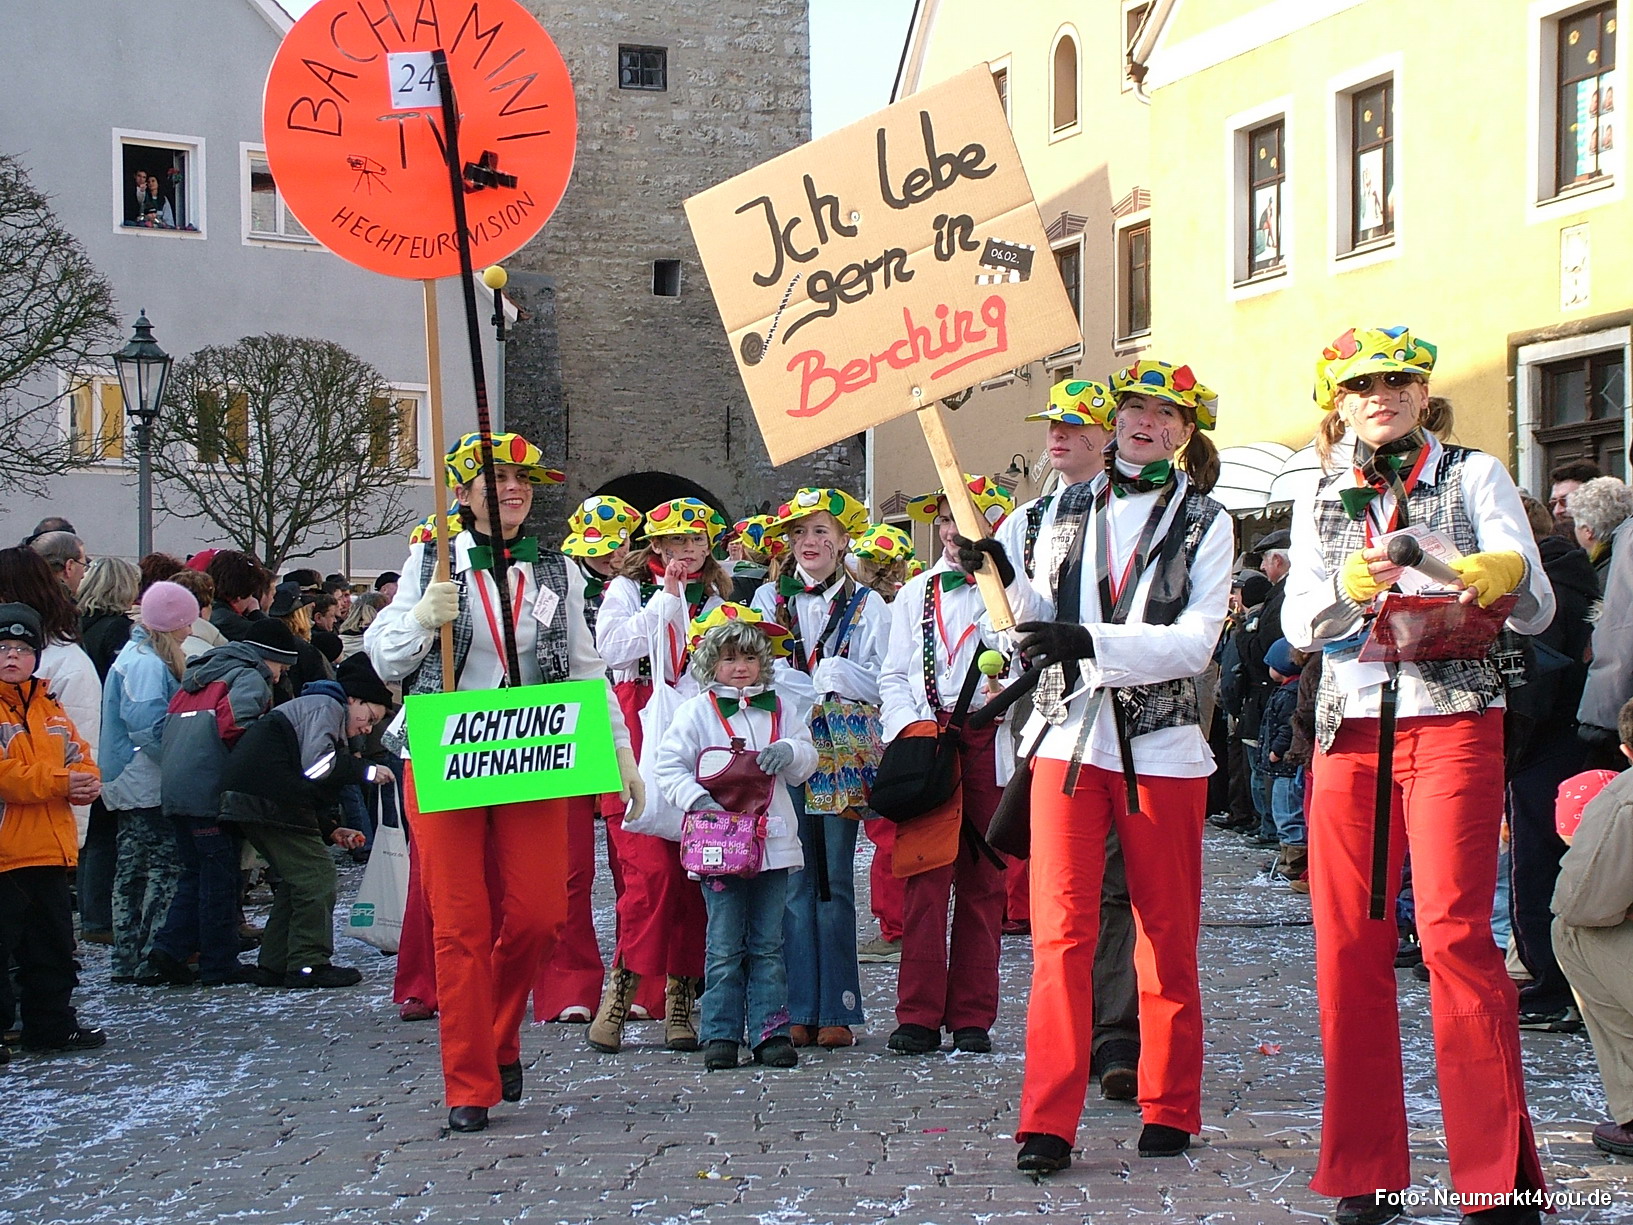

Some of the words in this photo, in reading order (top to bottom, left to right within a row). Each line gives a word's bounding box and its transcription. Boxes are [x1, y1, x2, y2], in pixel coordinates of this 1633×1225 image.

[287, 0, 551, 141] BACHAMINI
[398, 63, 436, 92] 24
[735, 173, 858, 287] Ich
[782, 246, 915, 344] gern
[932, 213, 980, 262] in
[786, 294, 1008, 418] Berching
[446, 743, 572, 780] AUFNAHME!
[450, 703, 567, 746] ACHTUNG
